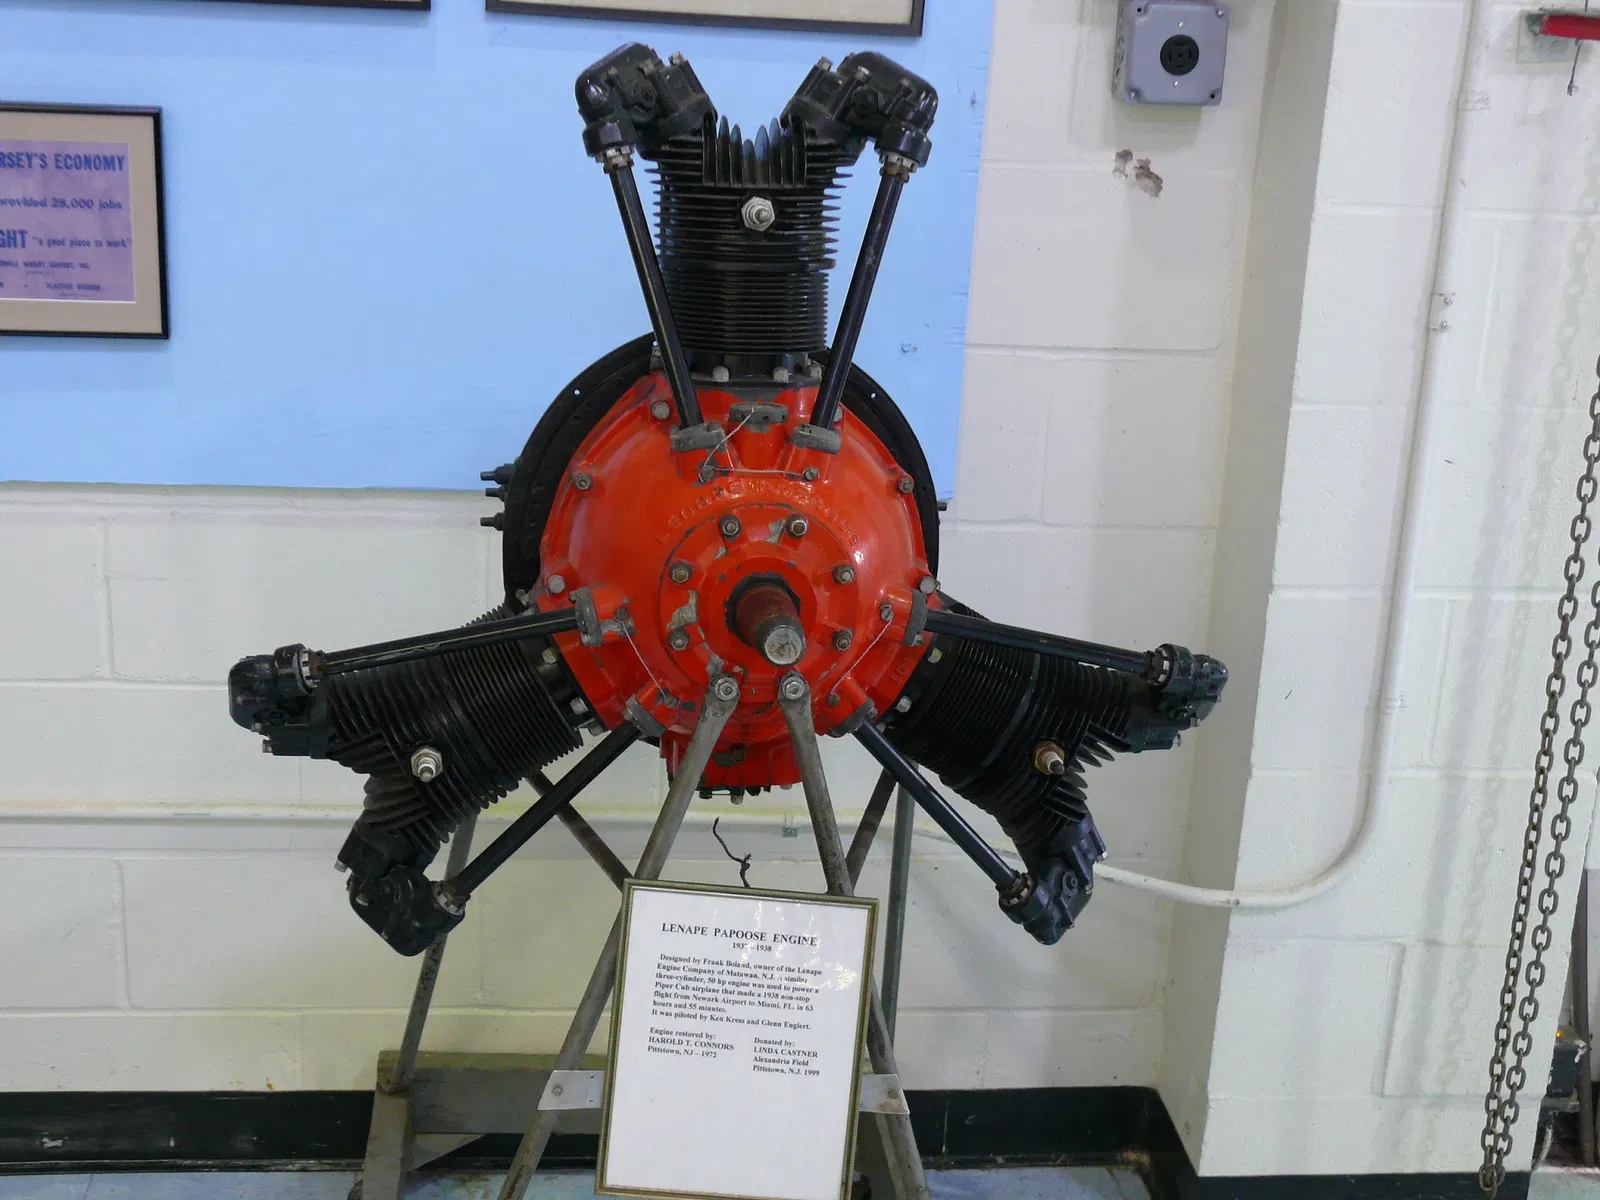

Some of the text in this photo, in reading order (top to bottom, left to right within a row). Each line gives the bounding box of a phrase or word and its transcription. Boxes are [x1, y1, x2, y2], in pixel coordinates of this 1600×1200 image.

[54, 154, 124, 172] ECONOMY
[98, 199, 122, 210] jobs
[47, 237, 65, 248] good
[70, 238, 91, 249] place
[96, 239, 103, 248] to
[662, 922, 817, 946] LENAPE PAPOOSE ENGINE
[756, 944, 772, 952] 1938
[657, 963, 680, 972] Engine
[682, 964, 714, 975] Company
[726, 969, 759, 979] Matawan,
[660, 954, 690, 963] Designed
[702, 958, 724, 966] Frank
[726, 960, 752, 969] Boland,
[798, 967, 822, 976] Lenape
[656, 972, 706, 984] three-cylinder,
[717, 977, 726, 986] hp
[728, 980, 750, 988] engine
[655, 981, 673, 990] Piper
[692, 985, 720, 994] airplane
[781, 994, 810, 1003] non-stop
[654, 990, 672, 998] flight
[692, 994, 719, 1003] Newark
[720, 997, 746, 1006] Airport
[757, 1001, 781, 1009] Miami,
[762, 1019, 782, 1027] Glenn
[784, 1021, 811, 1030] Englert.
[650, 1027, 673, 1036] Engine
[676, 1030, 703, 1039] restored
[649, 1036, 683, 1046] HAROLD
[694, 1041, 734, 1050] CONNORS
[754, 1037, 782, 1046] Donated
[648, 1045, 682, 1056] Pittstown,
[754, 1046, 818, 1058] LINDA CASTNER
[753, 1056, 790, 1065] Alexandria
[752, 1065, 786, 1074] Pittstown,
